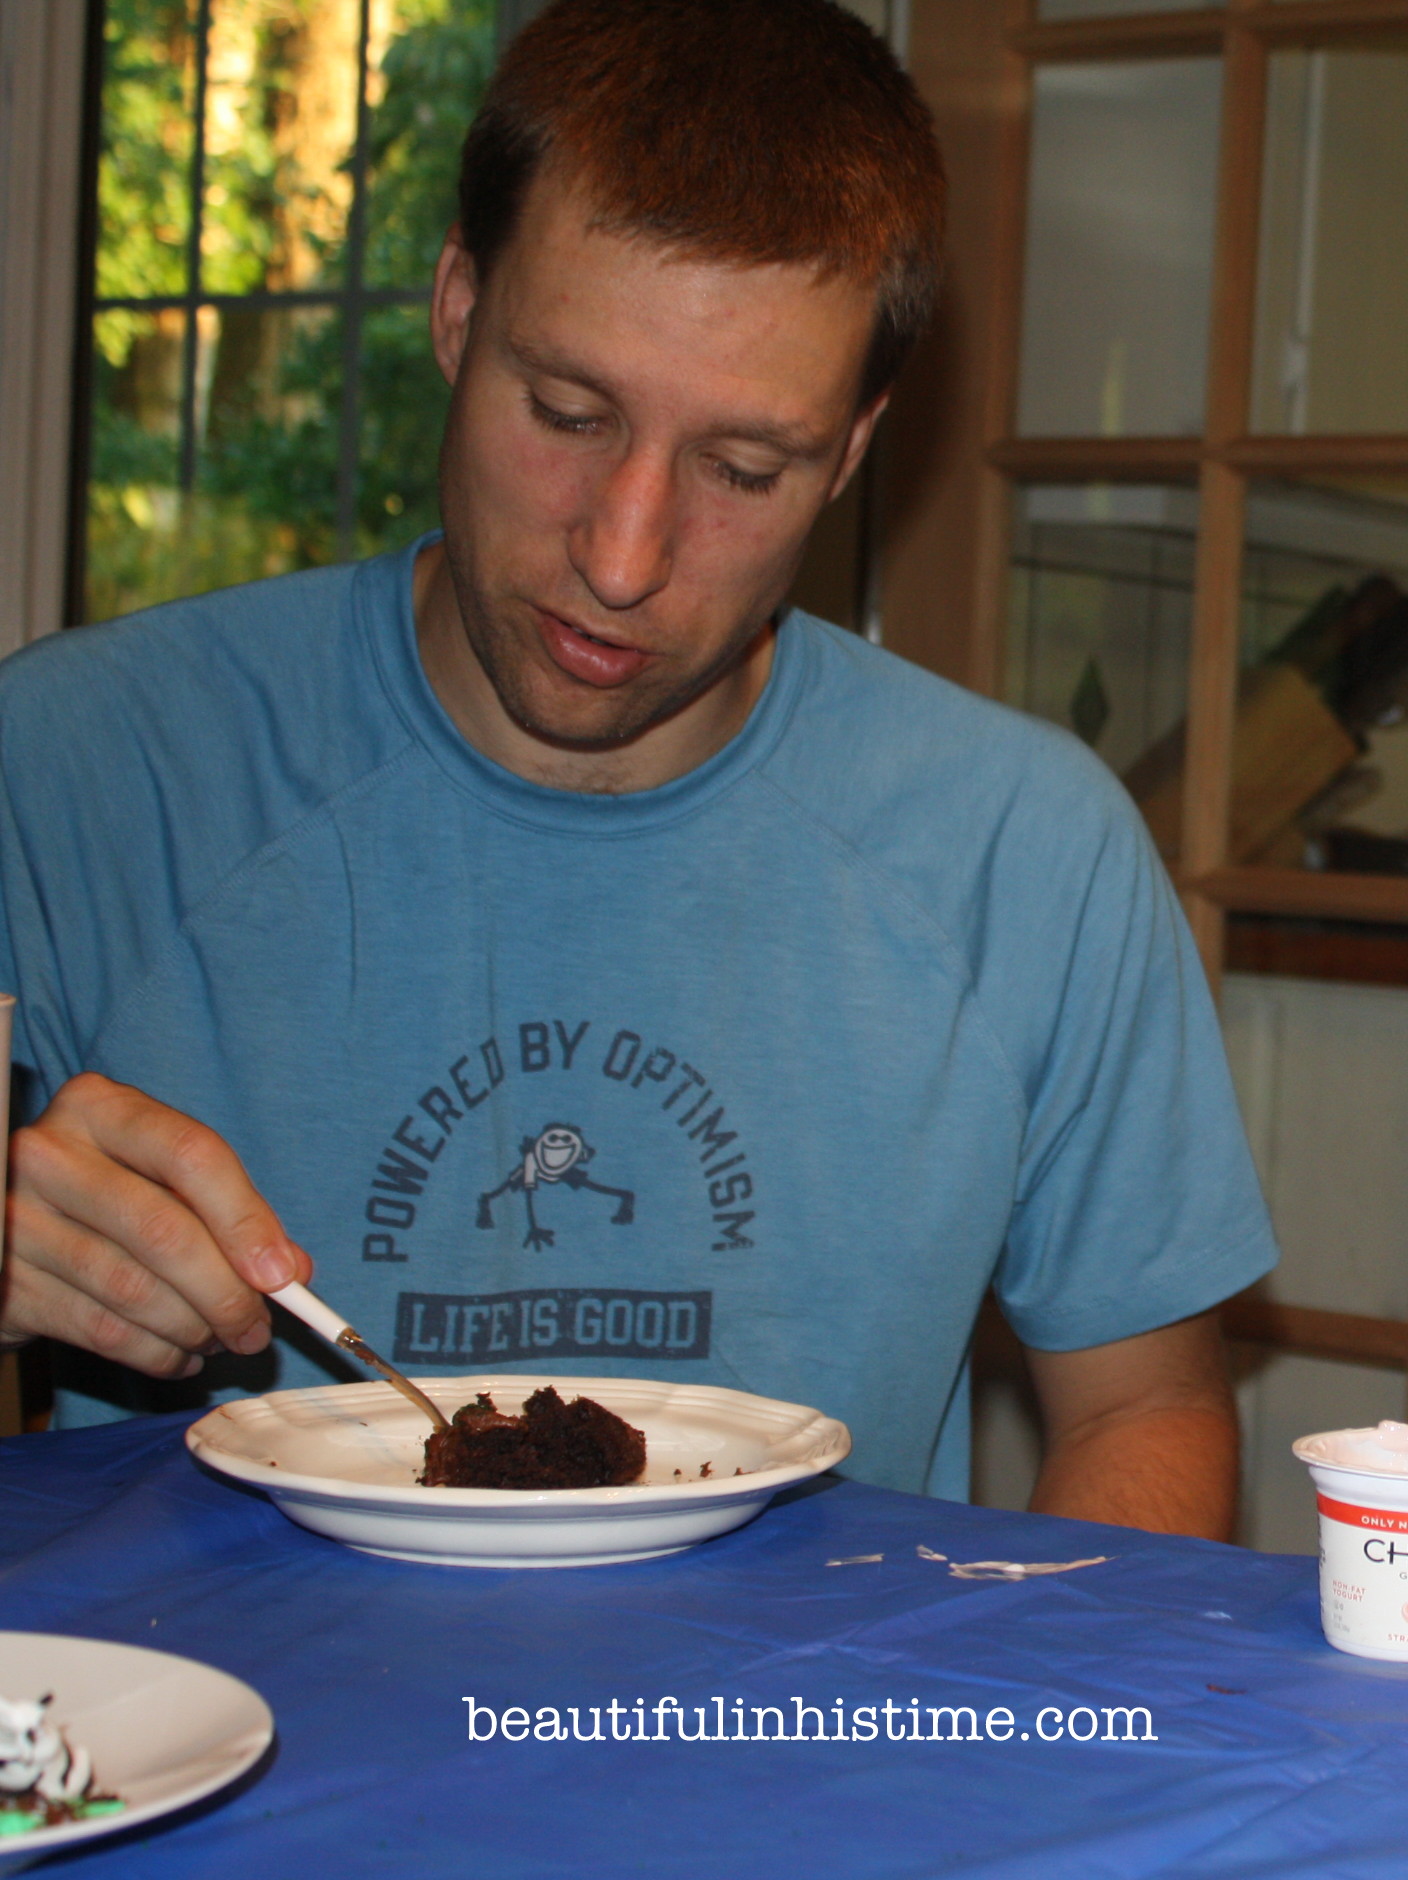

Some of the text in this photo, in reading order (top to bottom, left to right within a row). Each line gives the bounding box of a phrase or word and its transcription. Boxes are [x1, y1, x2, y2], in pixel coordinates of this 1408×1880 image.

[362, 1020, 756, 1262] POWERED BY OPTIMISM
[409, 1299, 697, 1352] LIFE IS GOOD
[1361, 1515, 1395, 1528] ONLY
[1333, 1588, 1363, 1602] YOGURT
